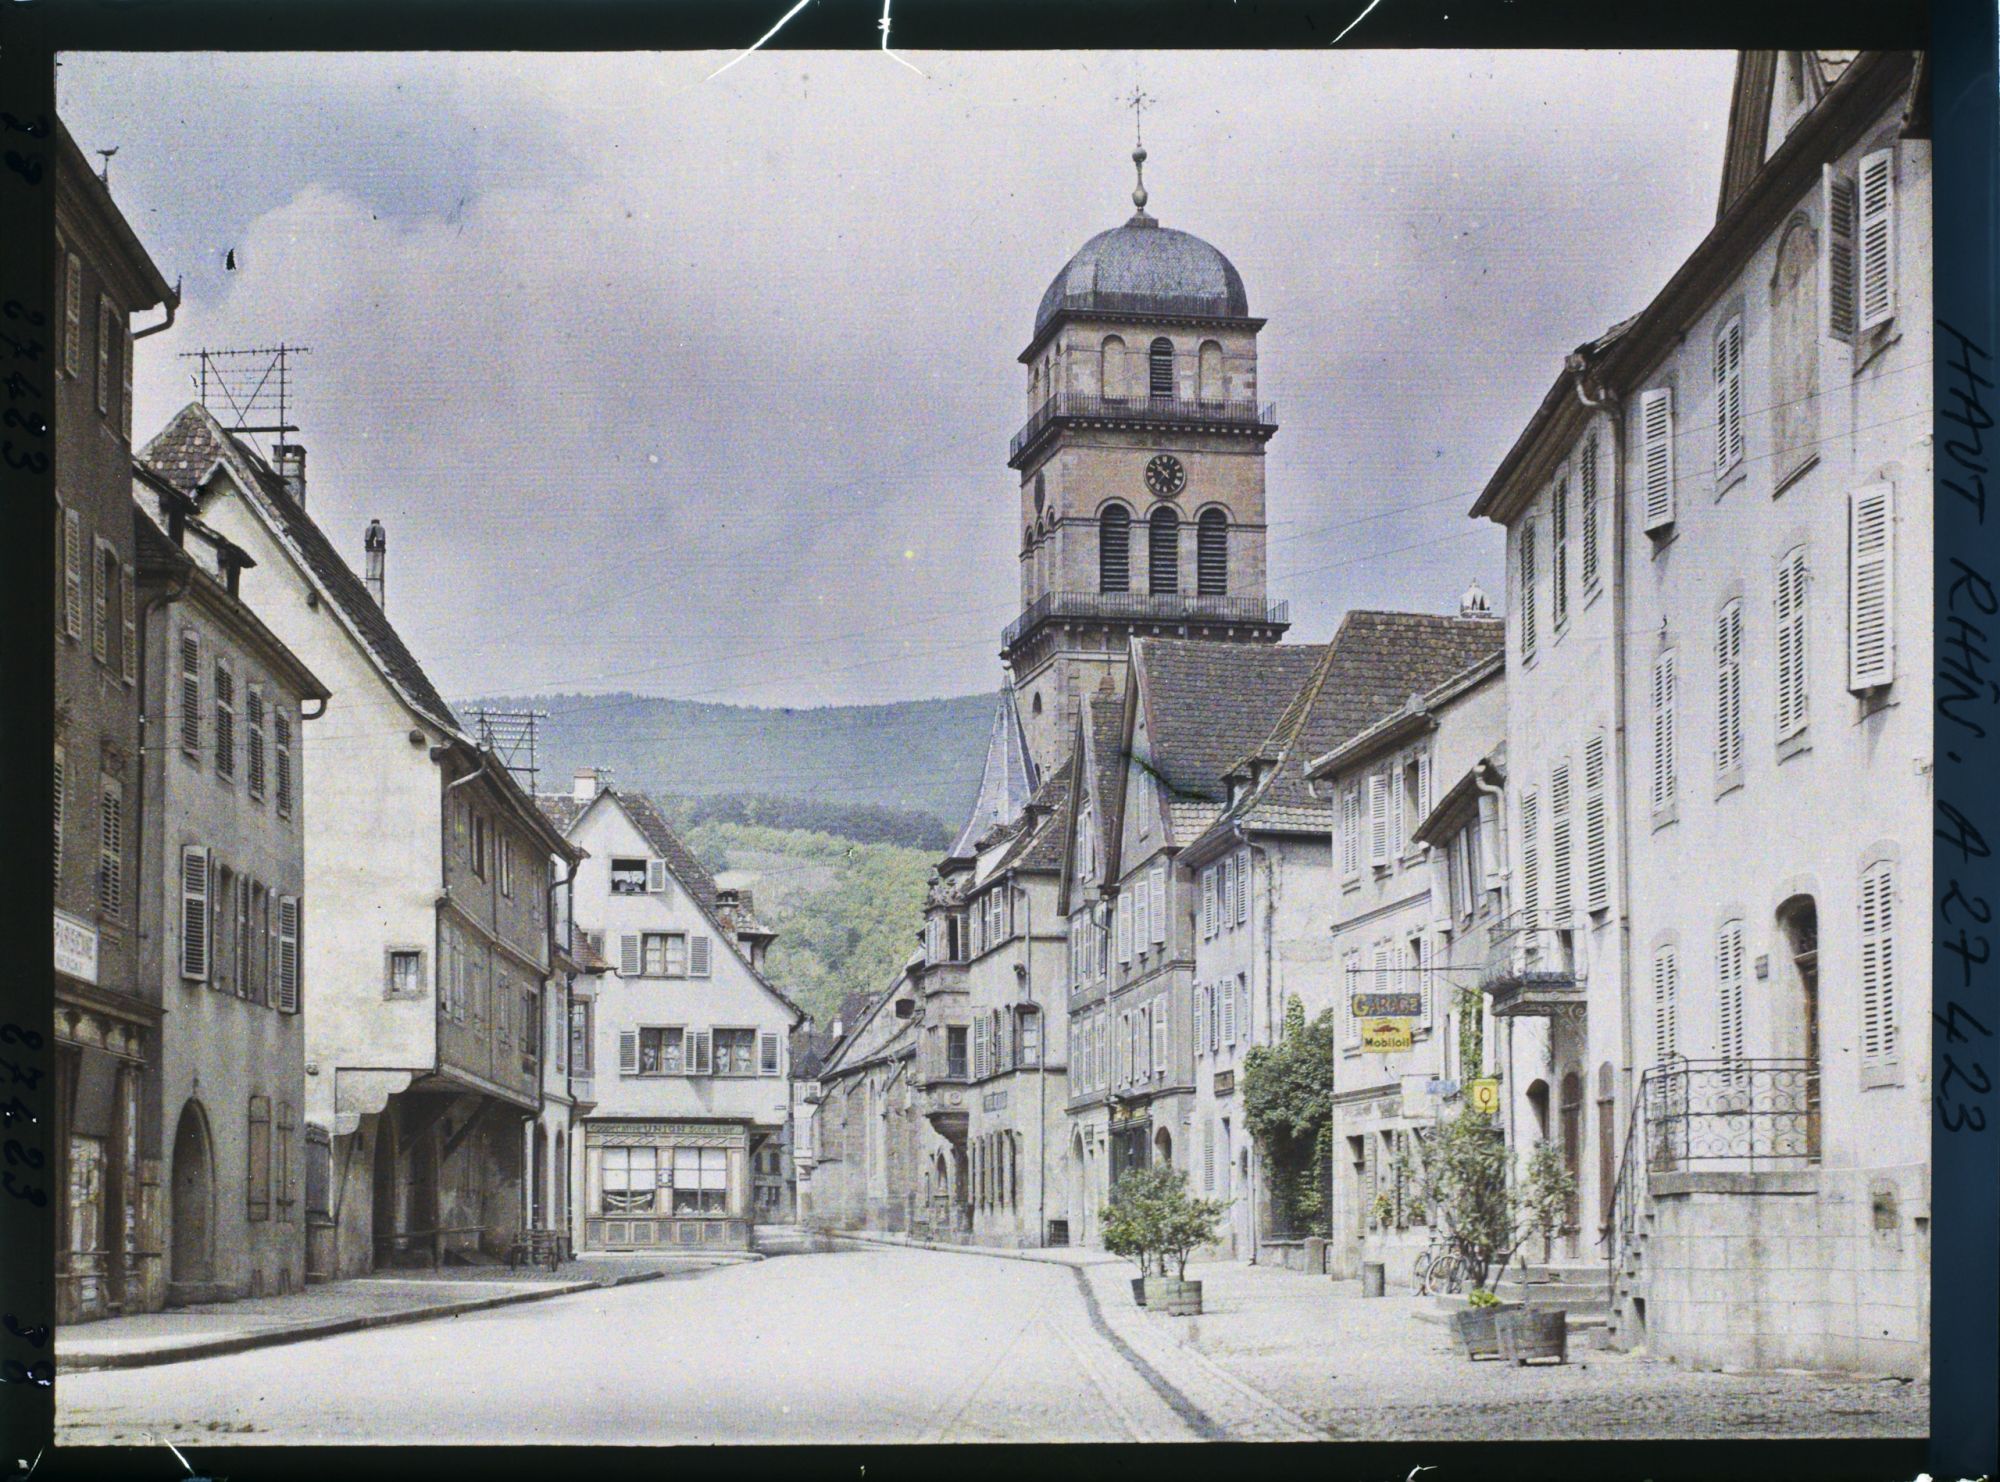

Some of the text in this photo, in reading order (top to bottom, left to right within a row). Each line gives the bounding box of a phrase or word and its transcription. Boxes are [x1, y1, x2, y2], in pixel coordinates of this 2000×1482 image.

[1936, 320, 1994, 526] HAUT
[1352, 994, 1418, 1016] GARAGE
[1365, 1035, 1409, 1047] Mobiloil
[643, 1124, 685, 1133] UNION
